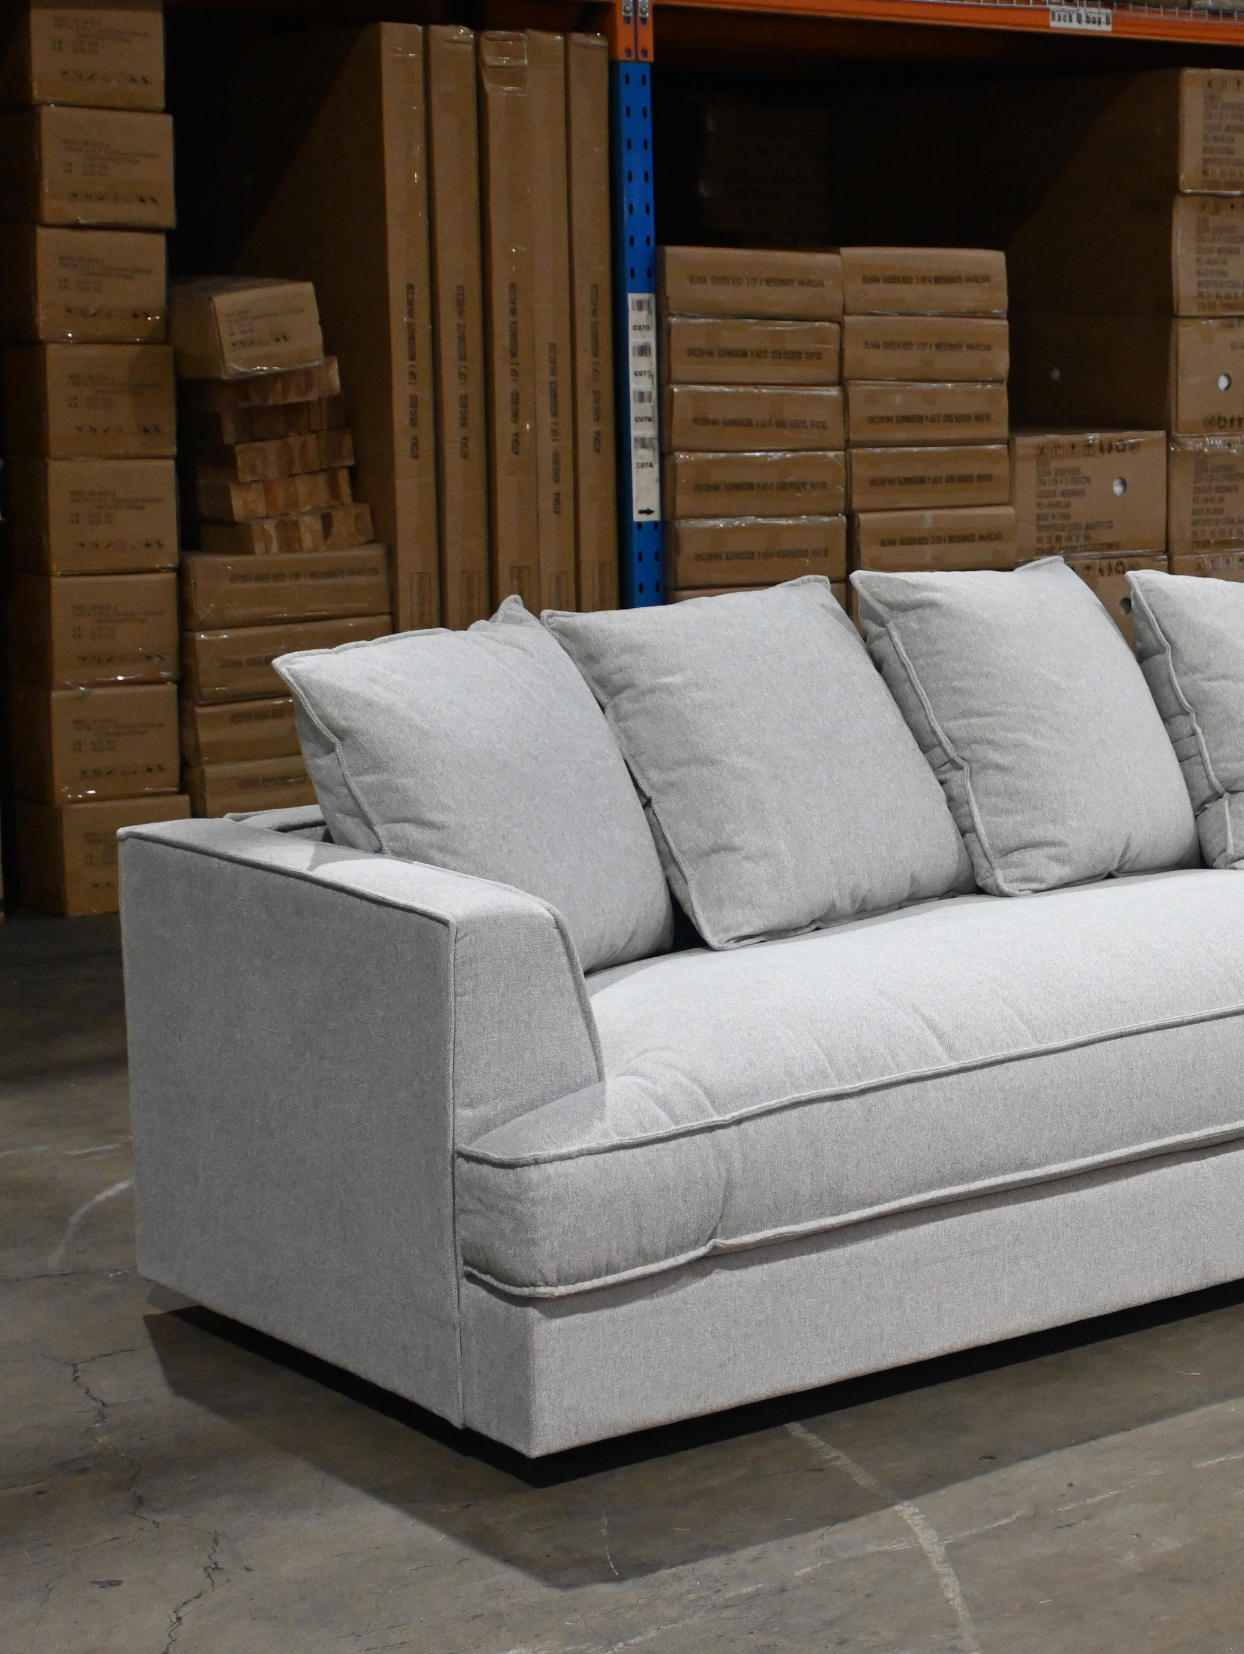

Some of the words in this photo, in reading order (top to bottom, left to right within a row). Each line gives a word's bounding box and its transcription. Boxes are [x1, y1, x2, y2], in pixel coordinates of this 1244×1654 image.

[407, 322, 416, 360] MESSMATE
[457, 322, 466, 361] MESSMATE
[509, 320, 518, 358] MESSMATE
[591, 320, 599, 358] MESSMATE
[408, 370, 416, 379] OF
[458, 370, 467, 380] OF
[510, 367, 518, 376] OF
[591, 366, 599, 376] OF
[408, 393, 417, 408] BED
[458, 393, 467, 408] BED
[510, 390, 518, 405] BED
[549, 380, 558, 418] MESSMATE
[592, 389, 600, 404] BED
[409, 409, 417, 427] KING
[458, 410, 468, 427] KING
[510, 406, 519, 423] KING
[592, 405, 600, 422] KING
[550, 427, 559, 436] OF
[409, 436, 418, 459] ATOKA
[459, 435, 469, 459] ATOKA
[510, 432, 519, 455] ATOKA
[592, 430, 601, 453] ATOKA
[551, 450, 559, 464] BED
[551, 466, 560, 483] KING
[552, 491, 560, 514] ATOKA
